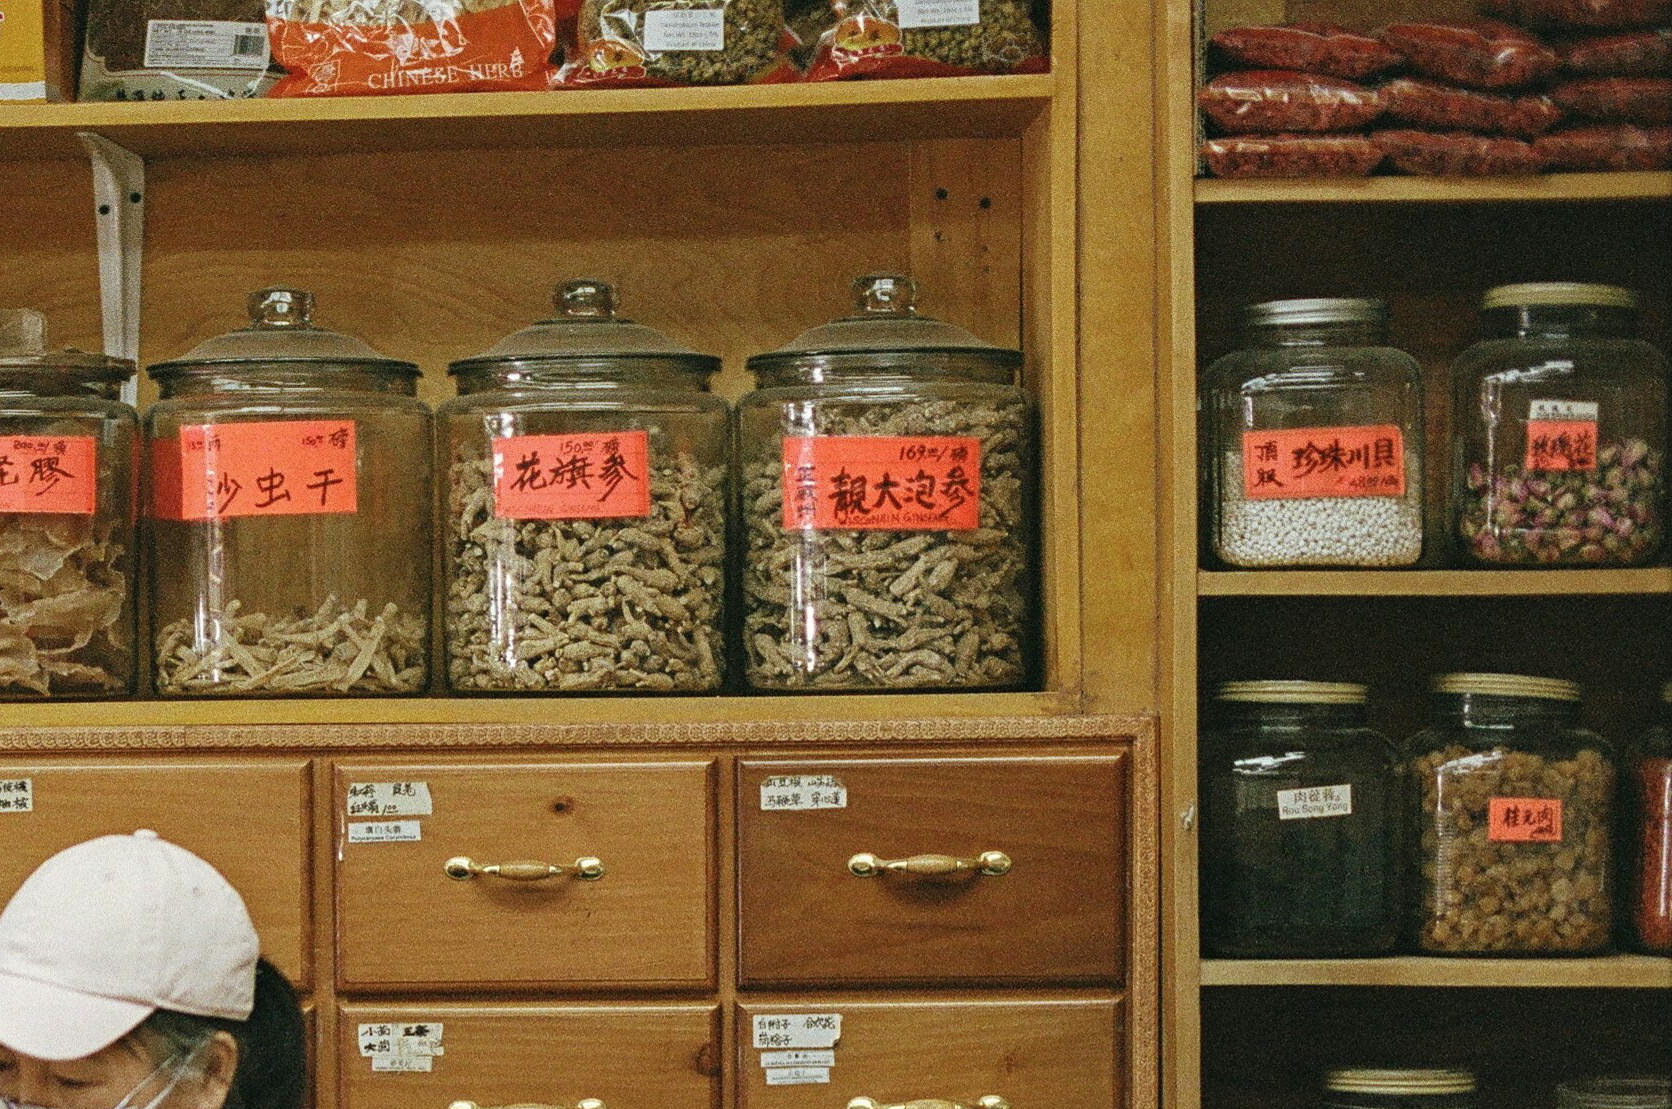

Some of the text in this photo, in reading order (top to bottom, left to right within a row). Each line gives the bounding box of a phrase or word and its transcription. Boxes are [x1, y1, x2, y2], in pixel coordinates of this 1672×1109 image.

[368, 61, 524, 90] CHINESE HERB
[1291, 438, 1395, 479] 珍珠川貝
